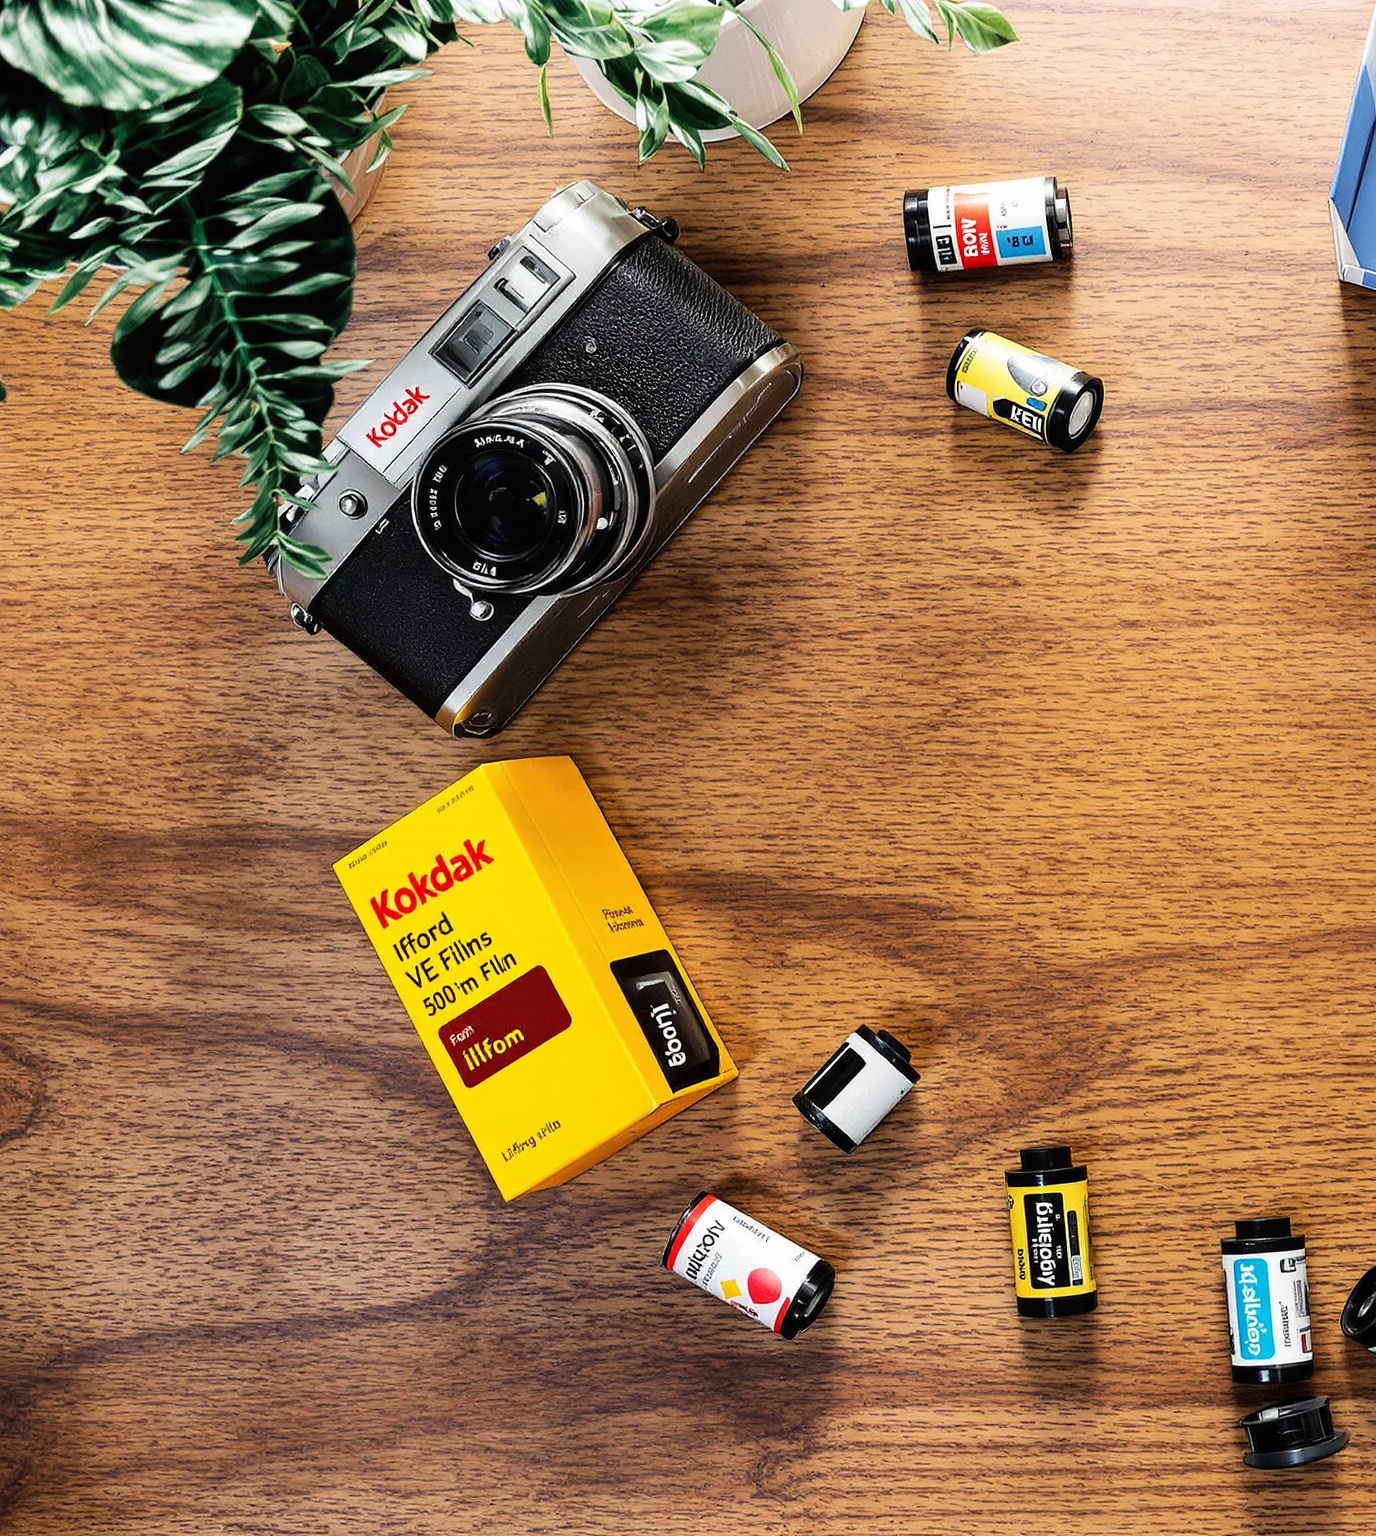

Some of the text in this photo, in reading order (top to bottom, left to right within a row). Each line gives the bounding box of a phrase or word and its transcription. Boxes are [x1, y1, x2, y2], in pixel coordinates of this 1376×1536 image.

[365, 385, 431, 449] Kodak
[370, 839, 494, 929] Kokdak
[405, 957, 439, 989] VE
